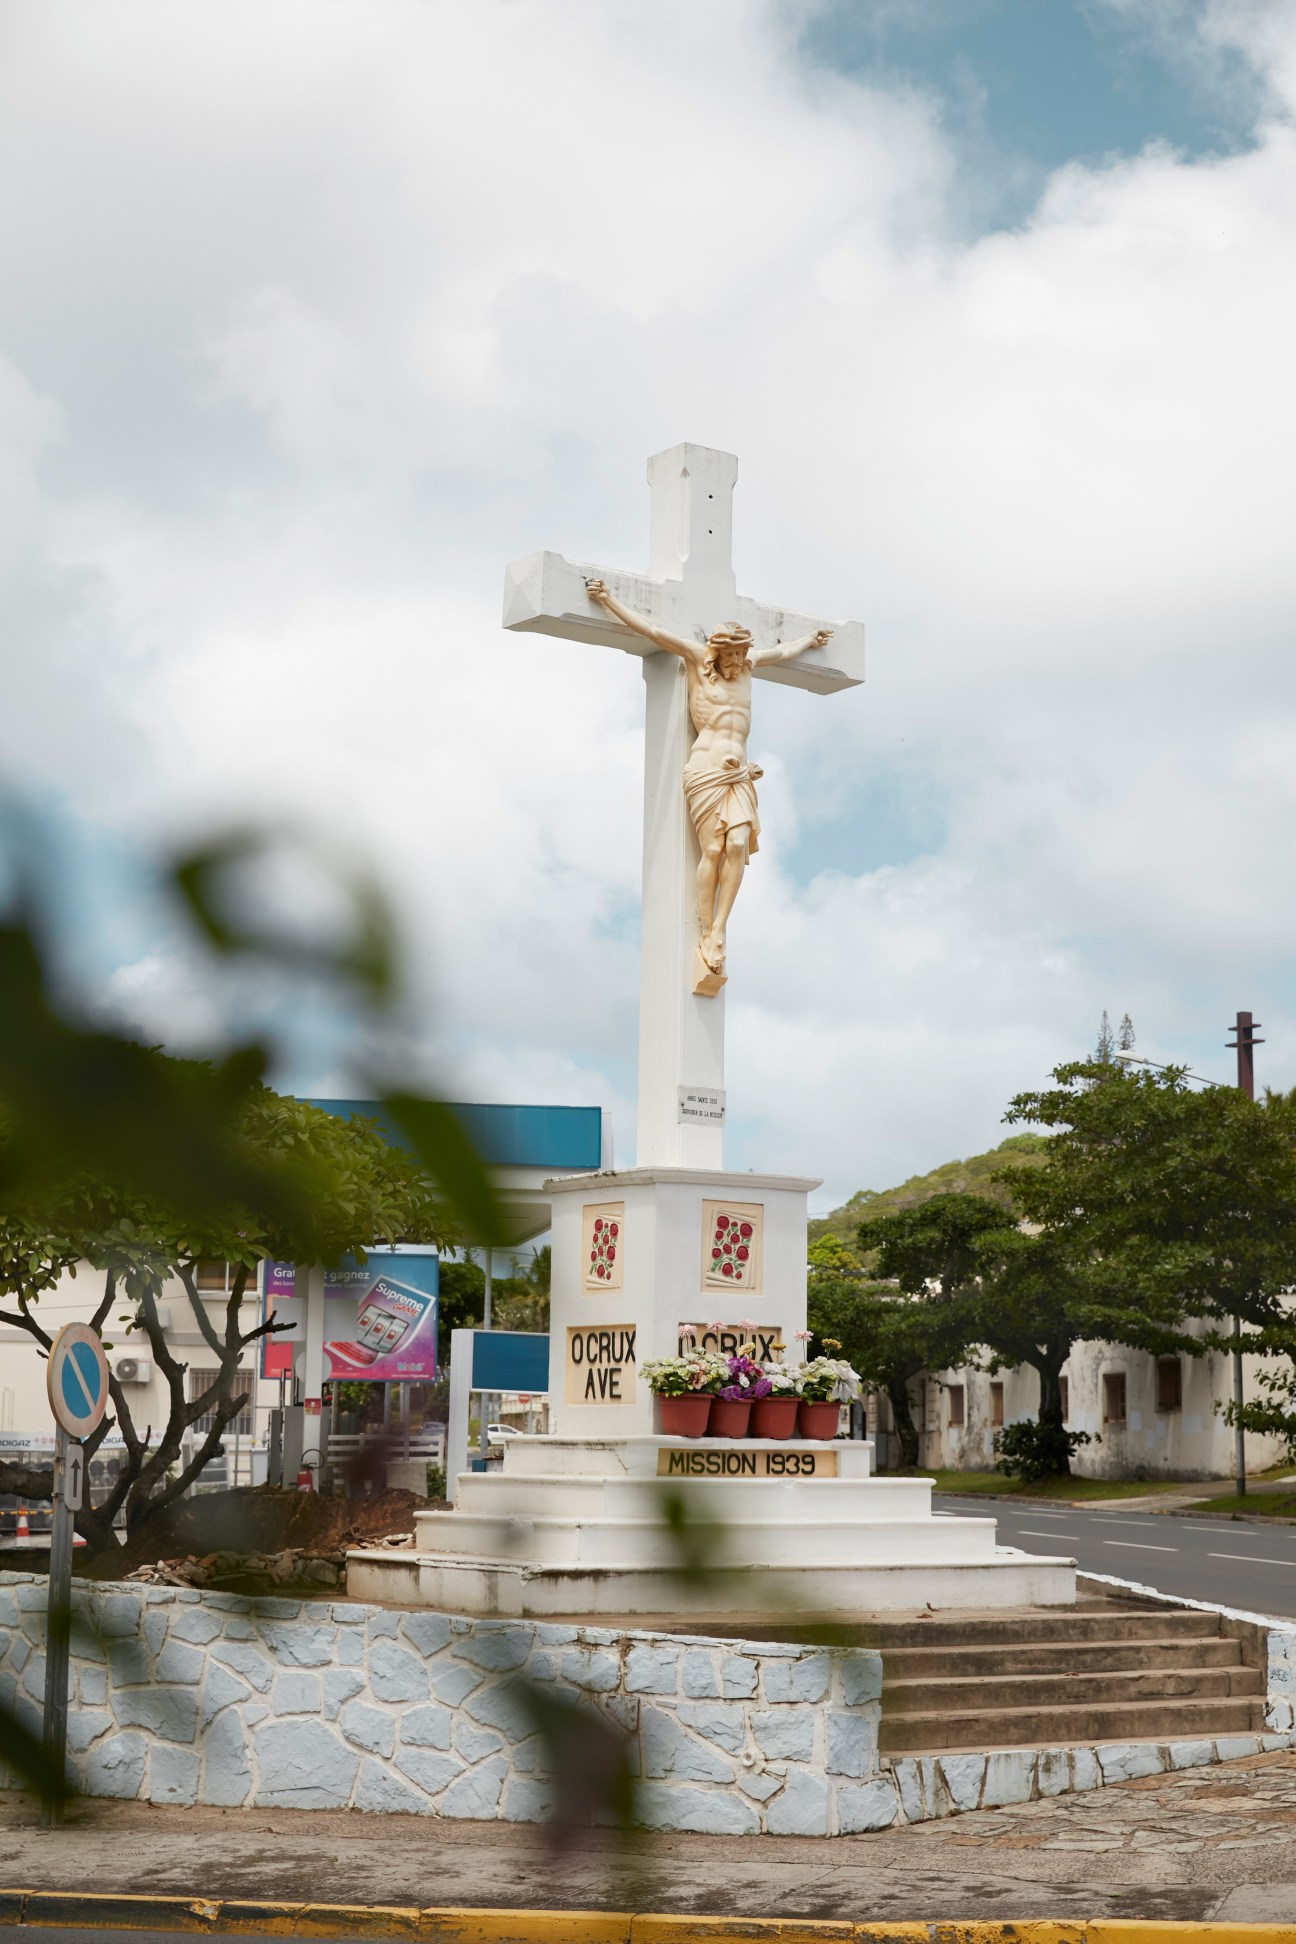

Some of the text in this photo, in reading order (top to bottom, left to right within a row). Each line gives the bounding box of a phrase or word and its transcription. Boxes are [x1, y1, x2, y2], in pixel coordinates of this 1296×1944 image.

[330, 1271, 370, 1282] gagnez
[375, 1282, 424, 1312] Supreme
[571, 1330, 636, 1364] O CRUX
[584, 1367, 622, 1400] AVE
[668, 1451, 816, 1475] MISSION 1939
